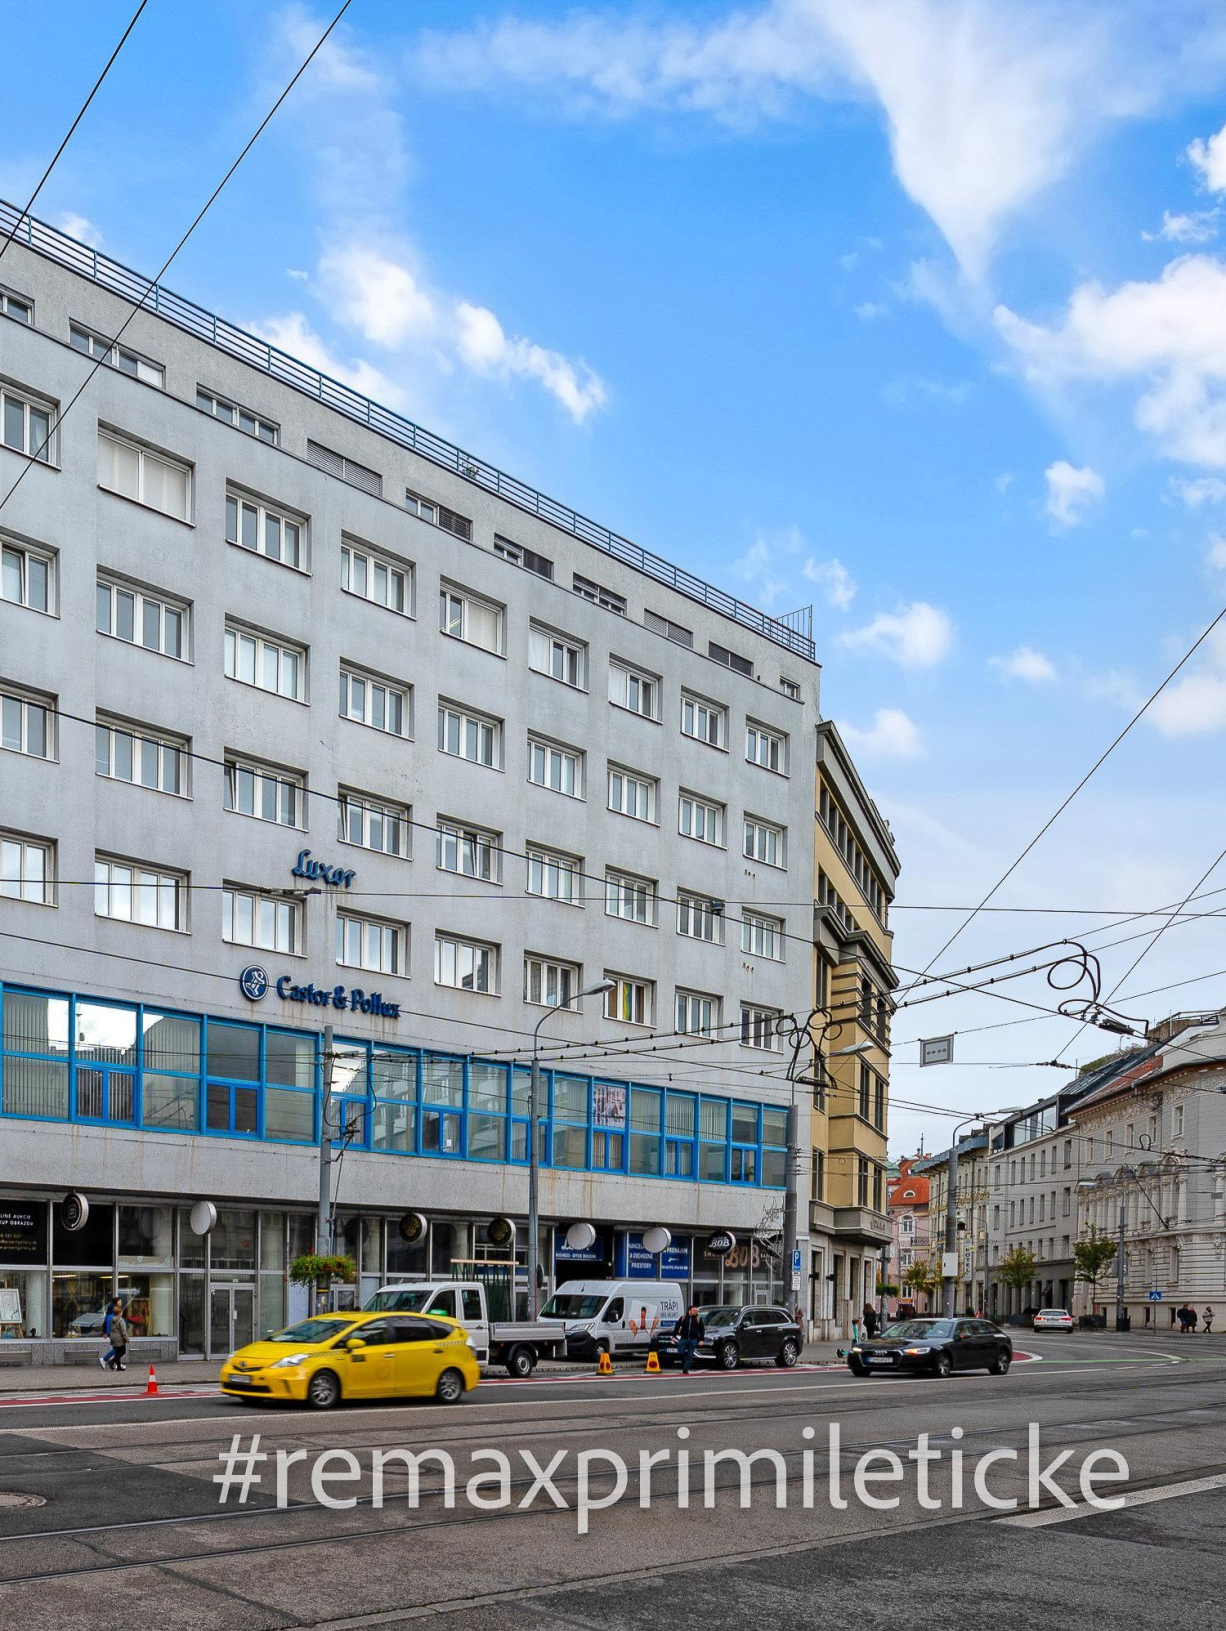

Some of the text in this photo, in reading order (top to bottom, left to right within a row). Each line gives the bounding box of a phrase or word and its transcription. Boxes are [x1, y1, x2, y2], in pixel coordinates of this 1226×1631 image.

[291, 849, 357, 888] Luxor
[277, 975, 402, 1019] Castor & Pollux
[708, 1238, 730, 1248] BOB
[725, 1244, 760, 1268] BOB
[660, 1299, 679, 1311] TRÁPI
